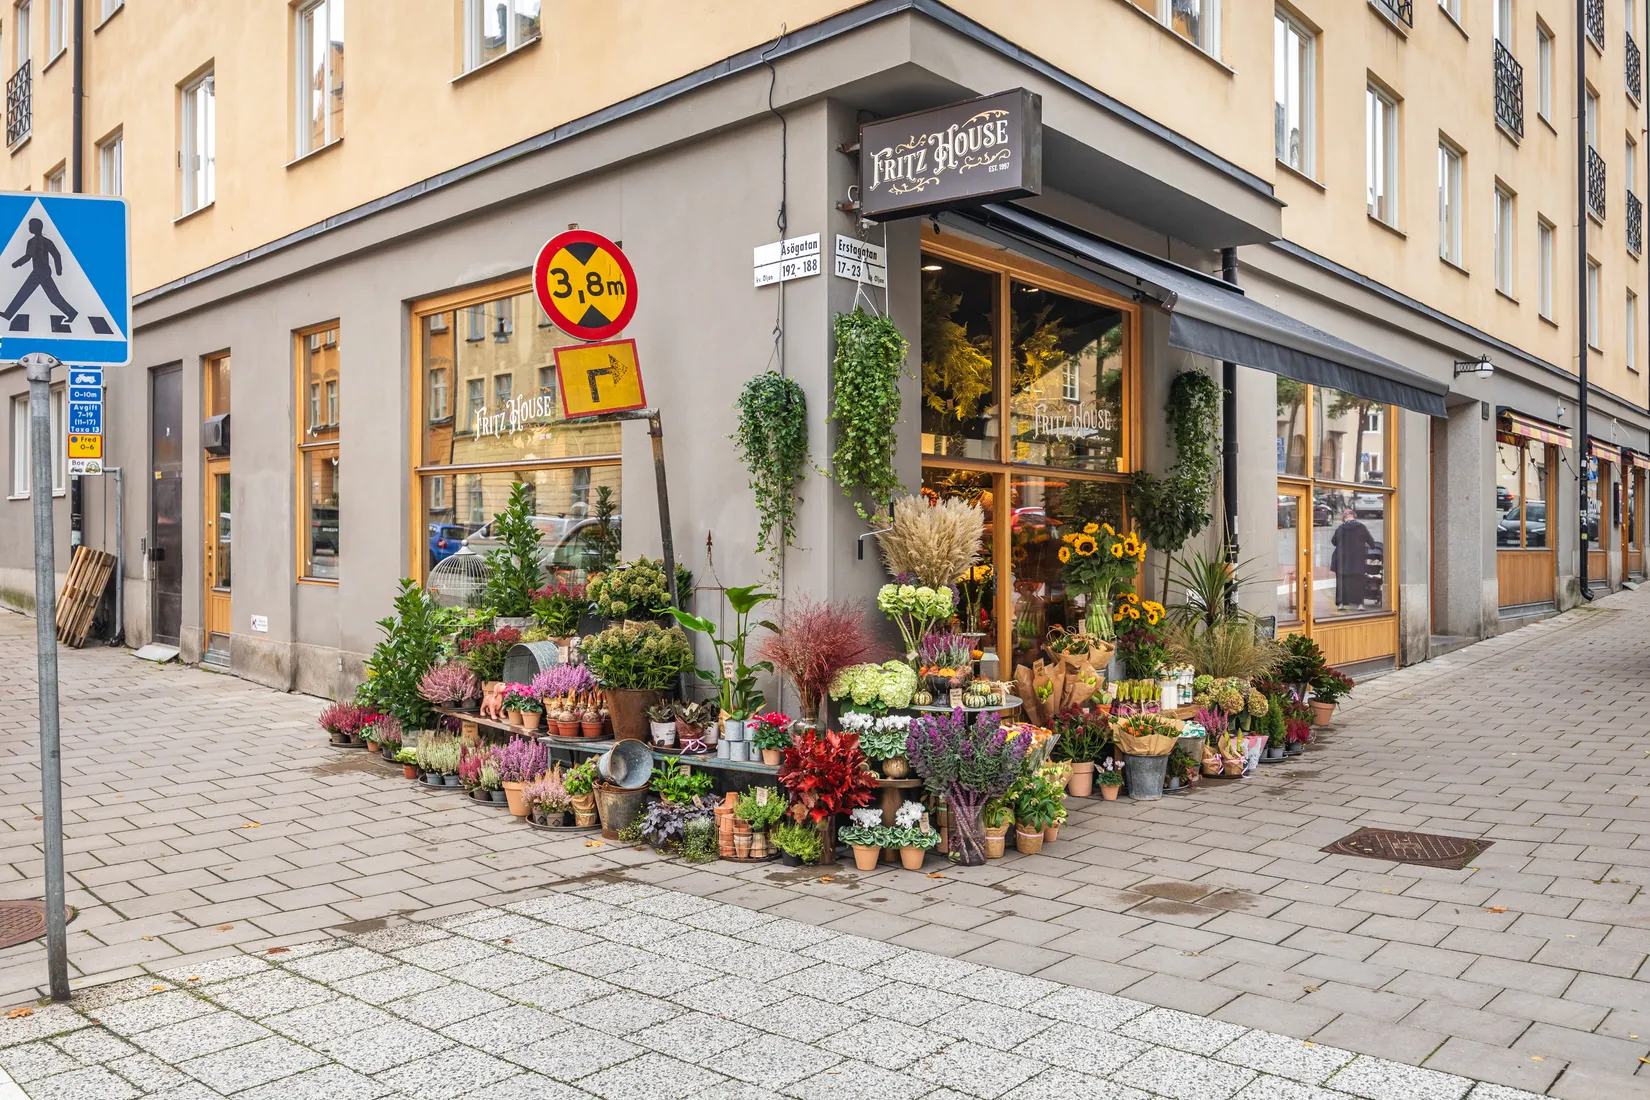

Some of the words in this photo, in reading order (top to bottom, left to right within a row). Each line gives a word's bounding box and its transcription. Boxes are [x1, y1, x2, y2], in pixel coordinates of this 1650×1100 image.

[928, 120, 1008, 175] HOUSE
[781, 240, 818, 256] Åsögatan
[838, 239, 878, 260] Erstagatan
[838, 261, 861, 278] 17-23
[506, 393, 551, 436] HOUSE
